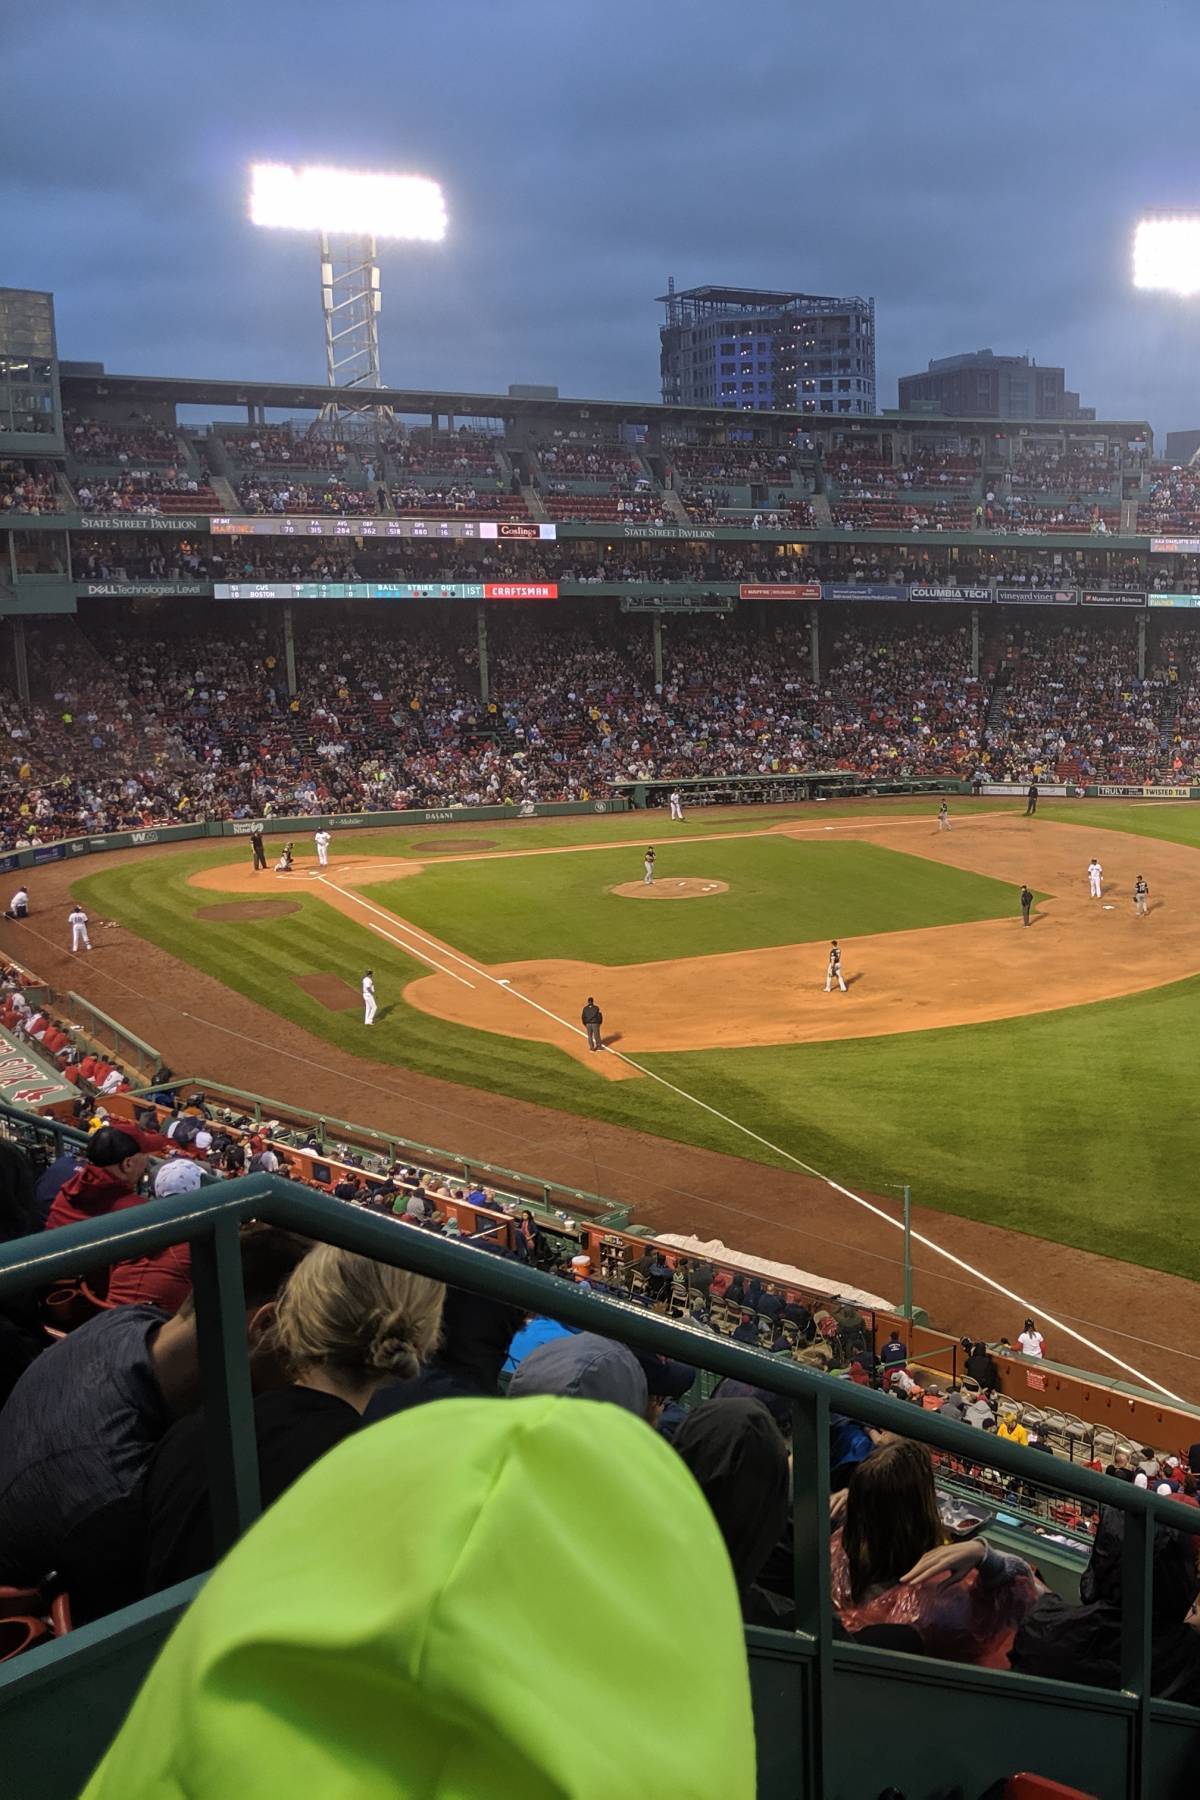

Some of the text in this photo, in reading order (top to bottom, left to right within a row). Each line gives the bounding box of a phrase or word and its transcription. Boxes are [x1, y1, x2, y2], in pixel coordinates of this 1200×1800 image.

[81, 518, 198, 529] STATE STREET PAVILION
[624, 528, 715, 538] STATE STREET PAVILION
[177, 584, 200, 594] Level
[492, 588, 549, 596] CRAFTSMAN
[912, 588, 988, 598] COLUMBIA TECH
[1000, 592, 1033, 600] vineyard
[1101, 788, 1124, 796] TRULY
